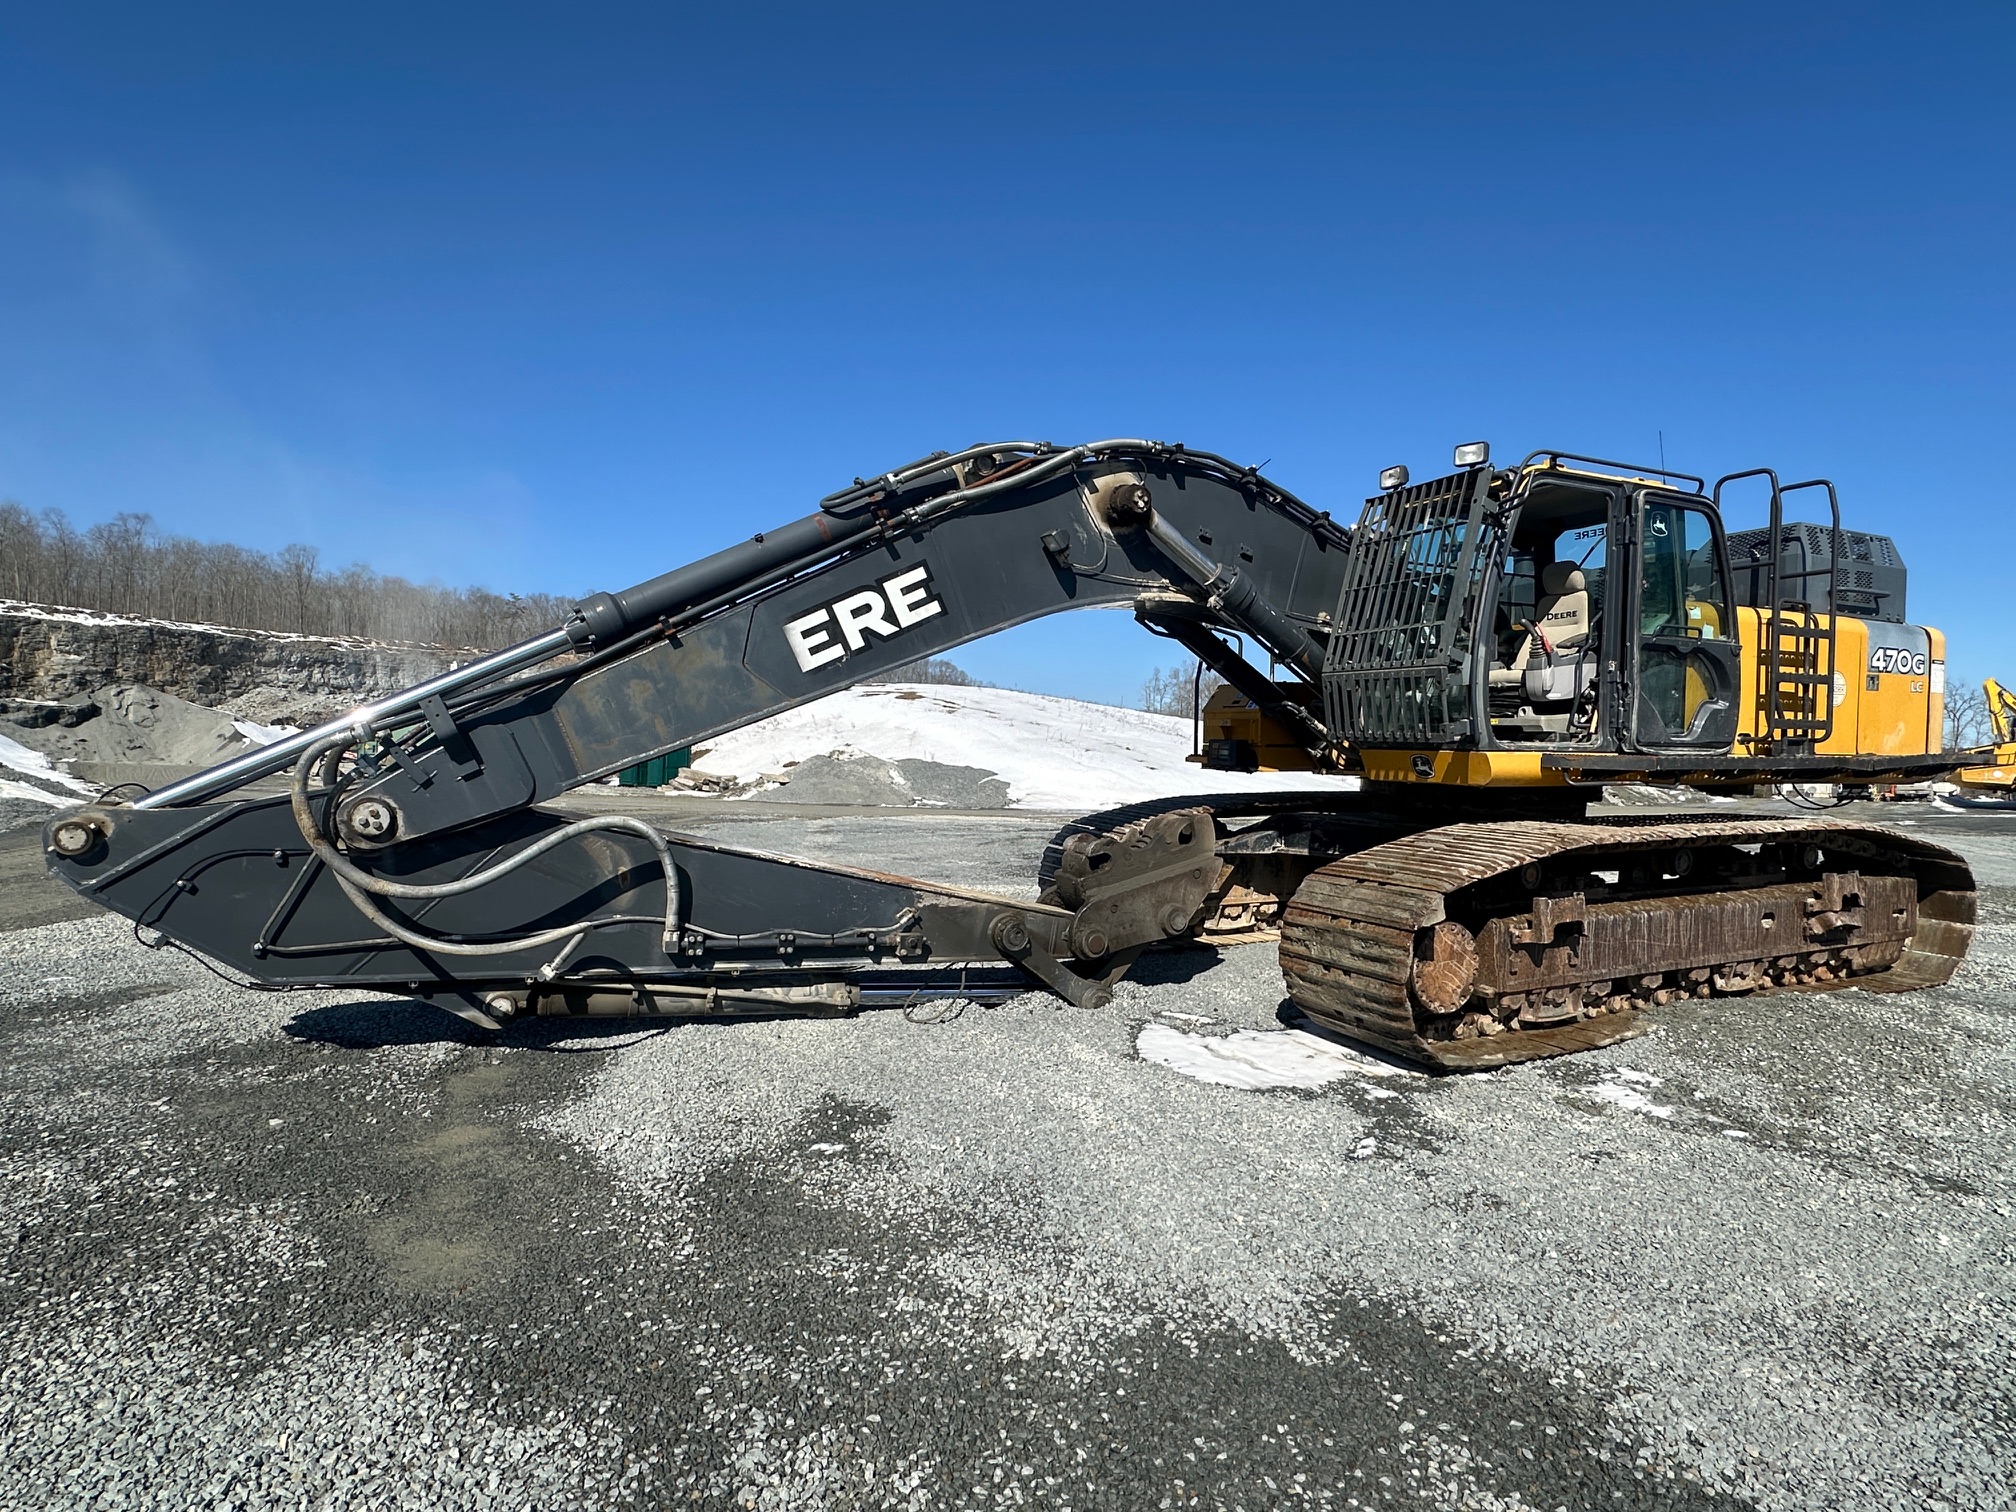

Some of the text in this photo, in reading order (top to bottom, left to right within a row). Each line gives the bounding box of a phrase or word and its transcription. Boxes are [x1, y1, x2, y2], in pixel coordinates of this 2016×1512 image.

[782, 566, 942, 673] ERE
[1546, 610, 1578, 620] DEERE
[1871, 647, 1925, 675] 470G
[1910, 681, 1923, 693] LC
